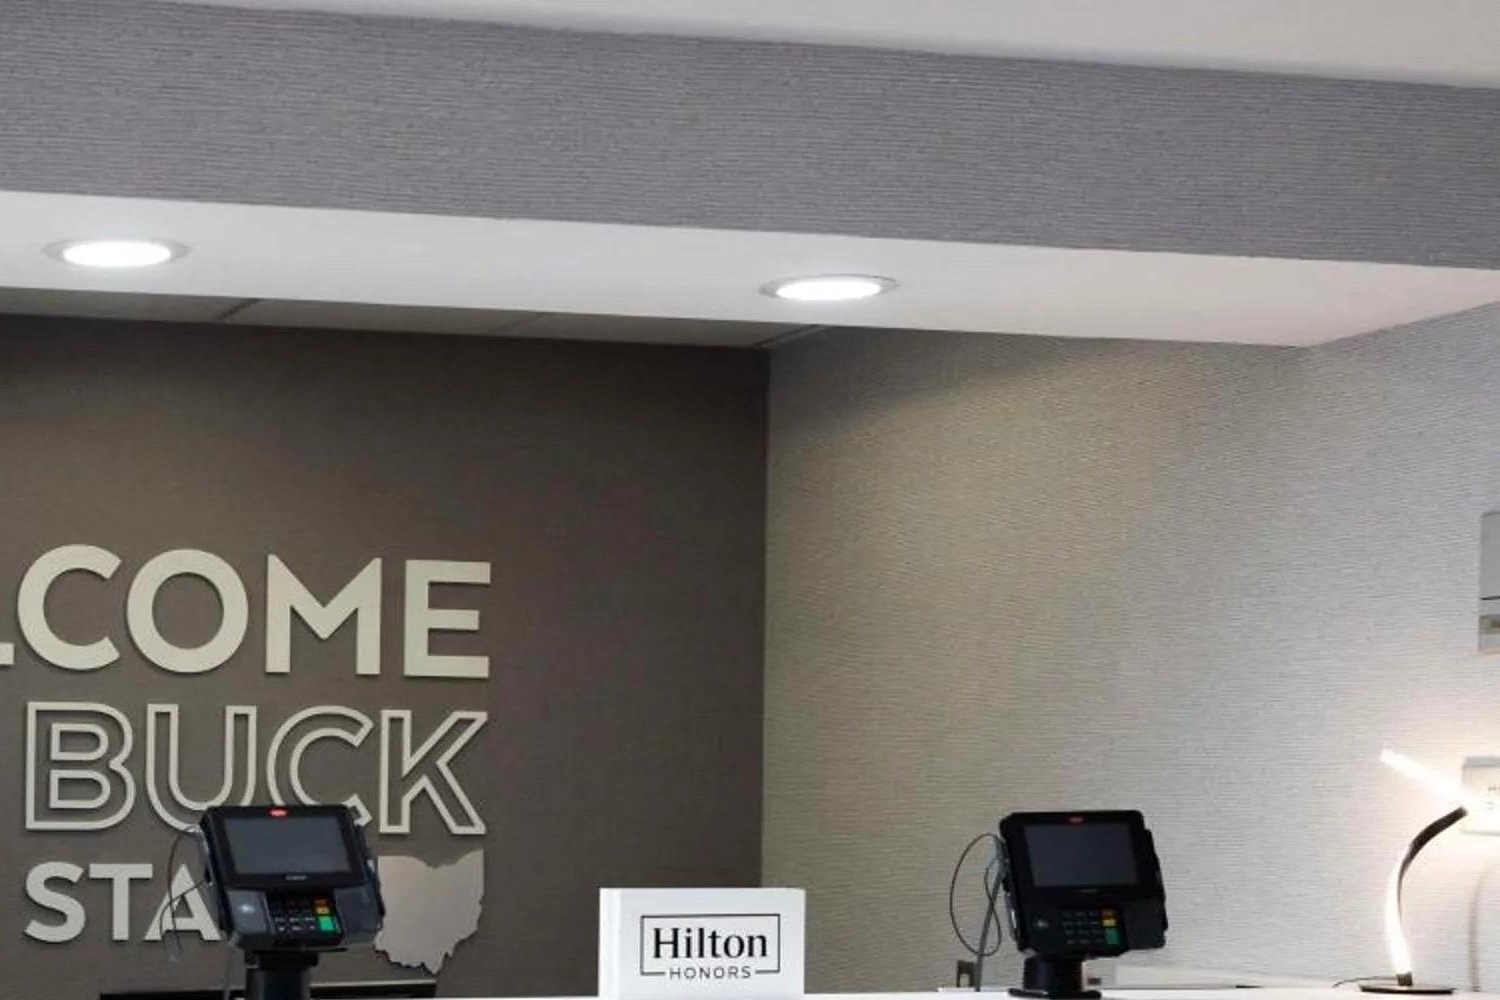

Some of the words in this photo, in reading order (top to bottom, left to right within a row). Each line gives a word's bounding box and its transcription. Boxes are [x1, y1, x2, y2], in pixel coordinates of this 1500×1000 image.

[25, 701, 488, 835] BUCK
[24, 861, 222, 942] STA
[653, 926, 768, 959] Hilton
[669, 965, 752, 980] HONORS
